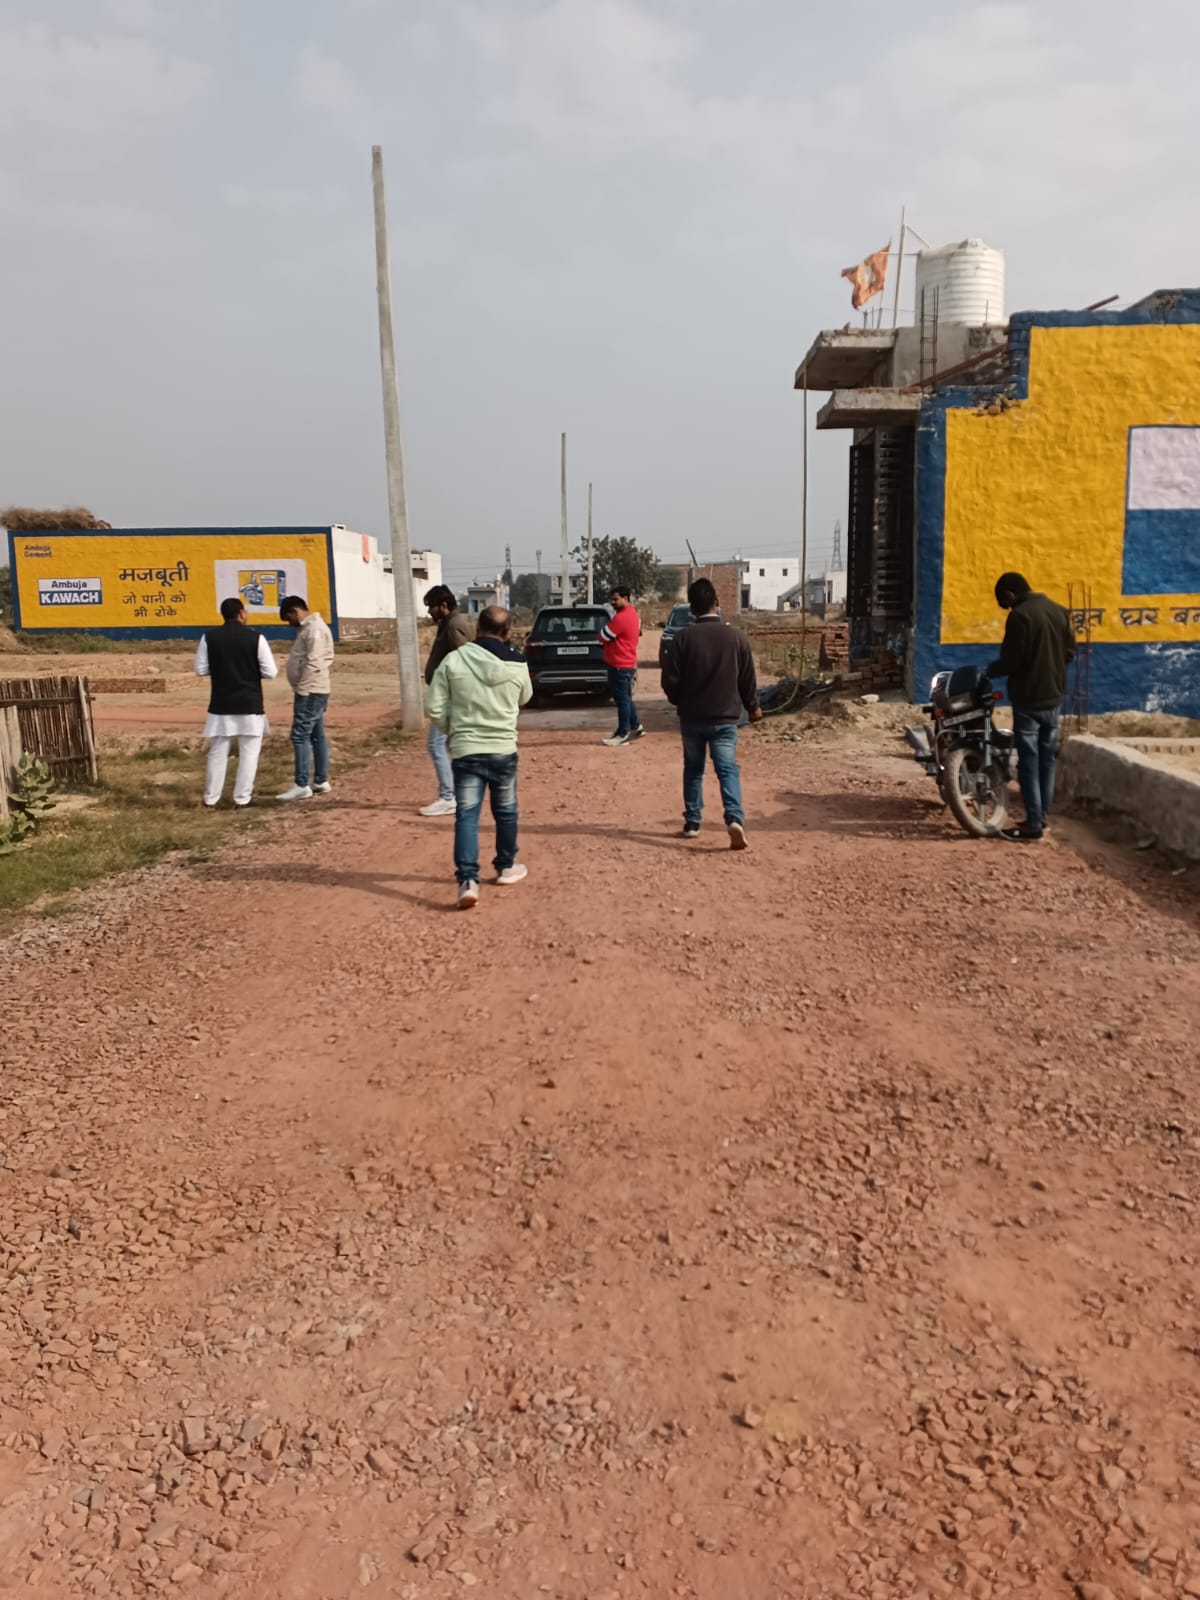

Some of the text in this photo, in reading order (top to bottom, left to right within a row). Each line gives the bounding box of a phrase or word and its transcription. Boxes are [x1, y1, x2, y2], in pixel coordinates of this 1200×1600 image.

[119, 560, 189, 587] मज़बूती
[51, 580, 87, 590] Ambuja
[41, 591, 99, 604] KAWACH
[121, 590, 187, 605] जो पानी को
[134, 605, 147, 617] भी
[1118, 607, 1160, 627] घर
